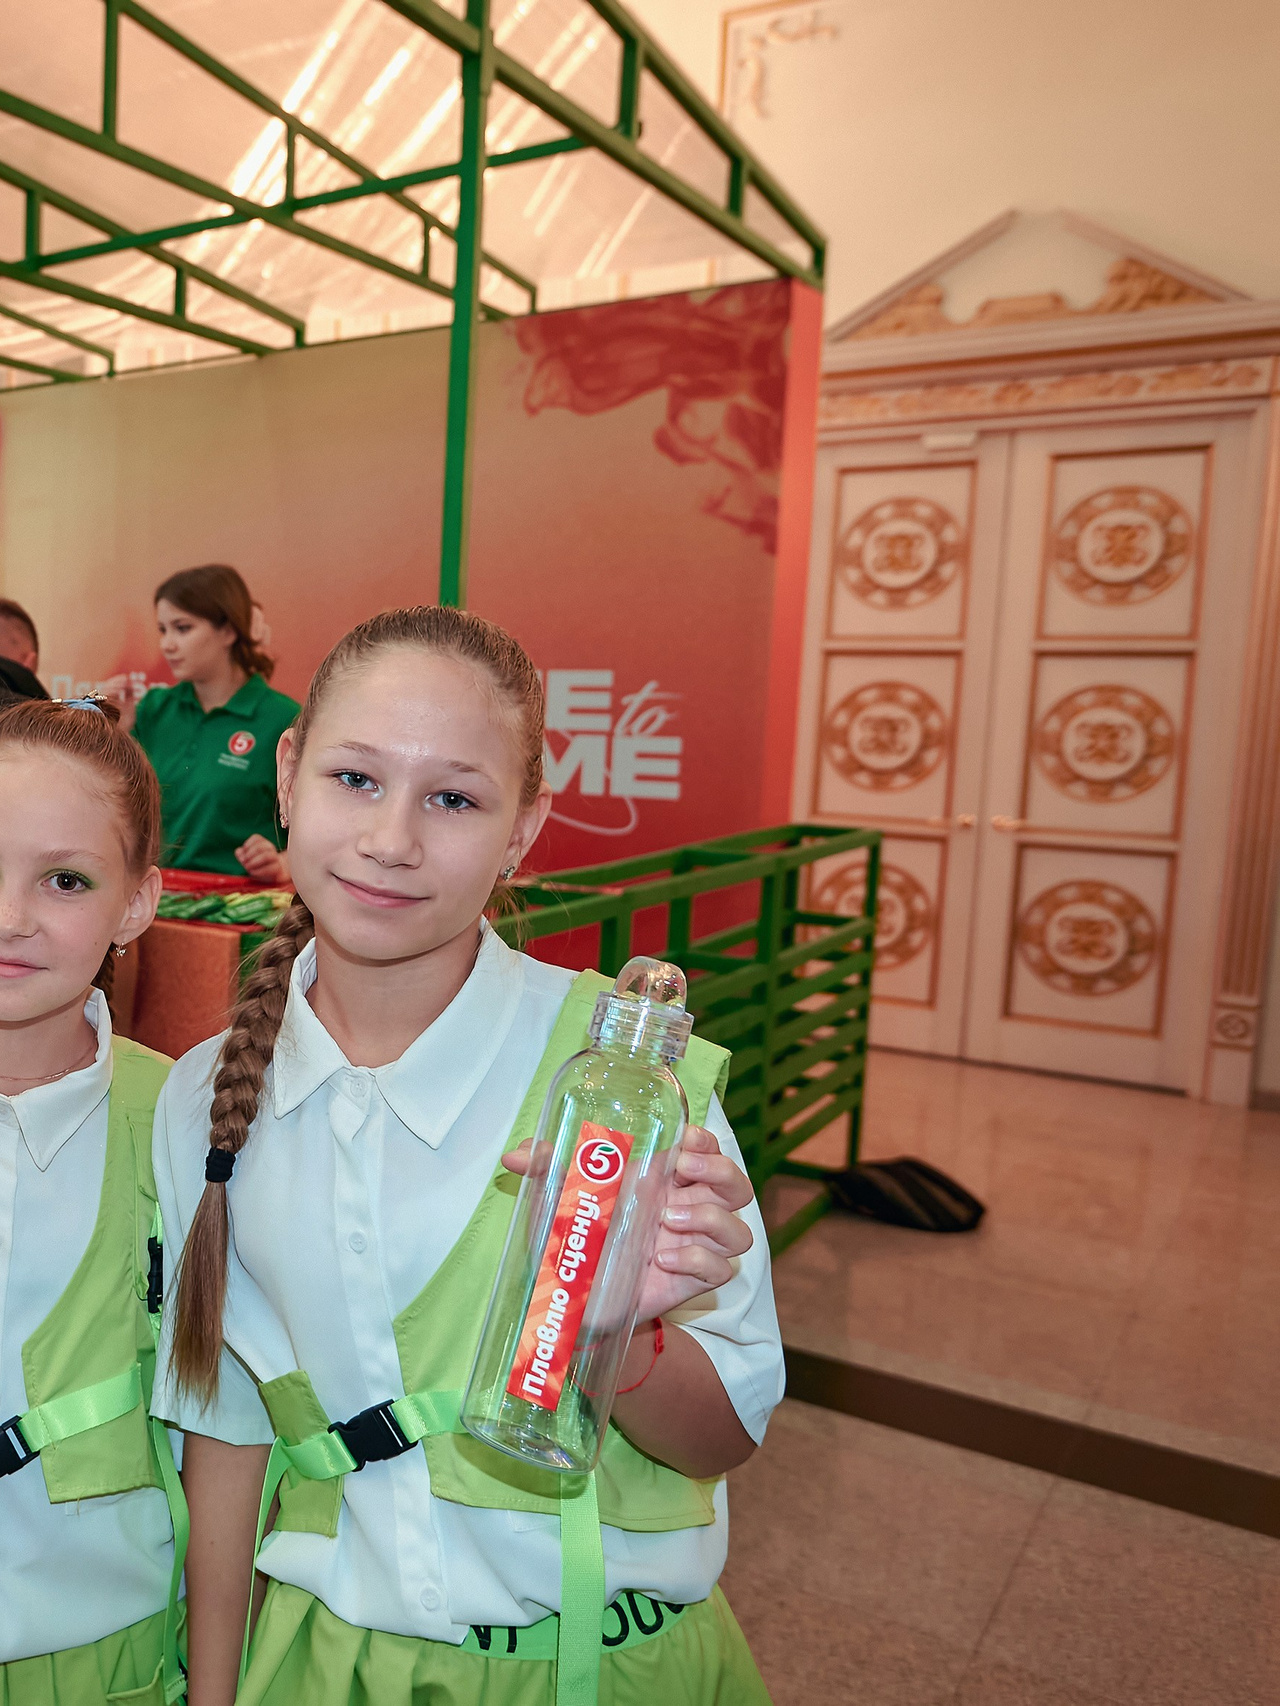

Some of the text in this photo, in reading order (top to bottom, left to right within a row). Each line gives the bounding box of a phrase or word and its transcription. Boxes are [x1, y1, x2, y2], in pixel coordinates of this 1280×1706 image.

[613, 680, 682, 738] to
[586, 1143, 616, 1175] 5
[522, 1190, 600, 1396] Плавлю сцену!
